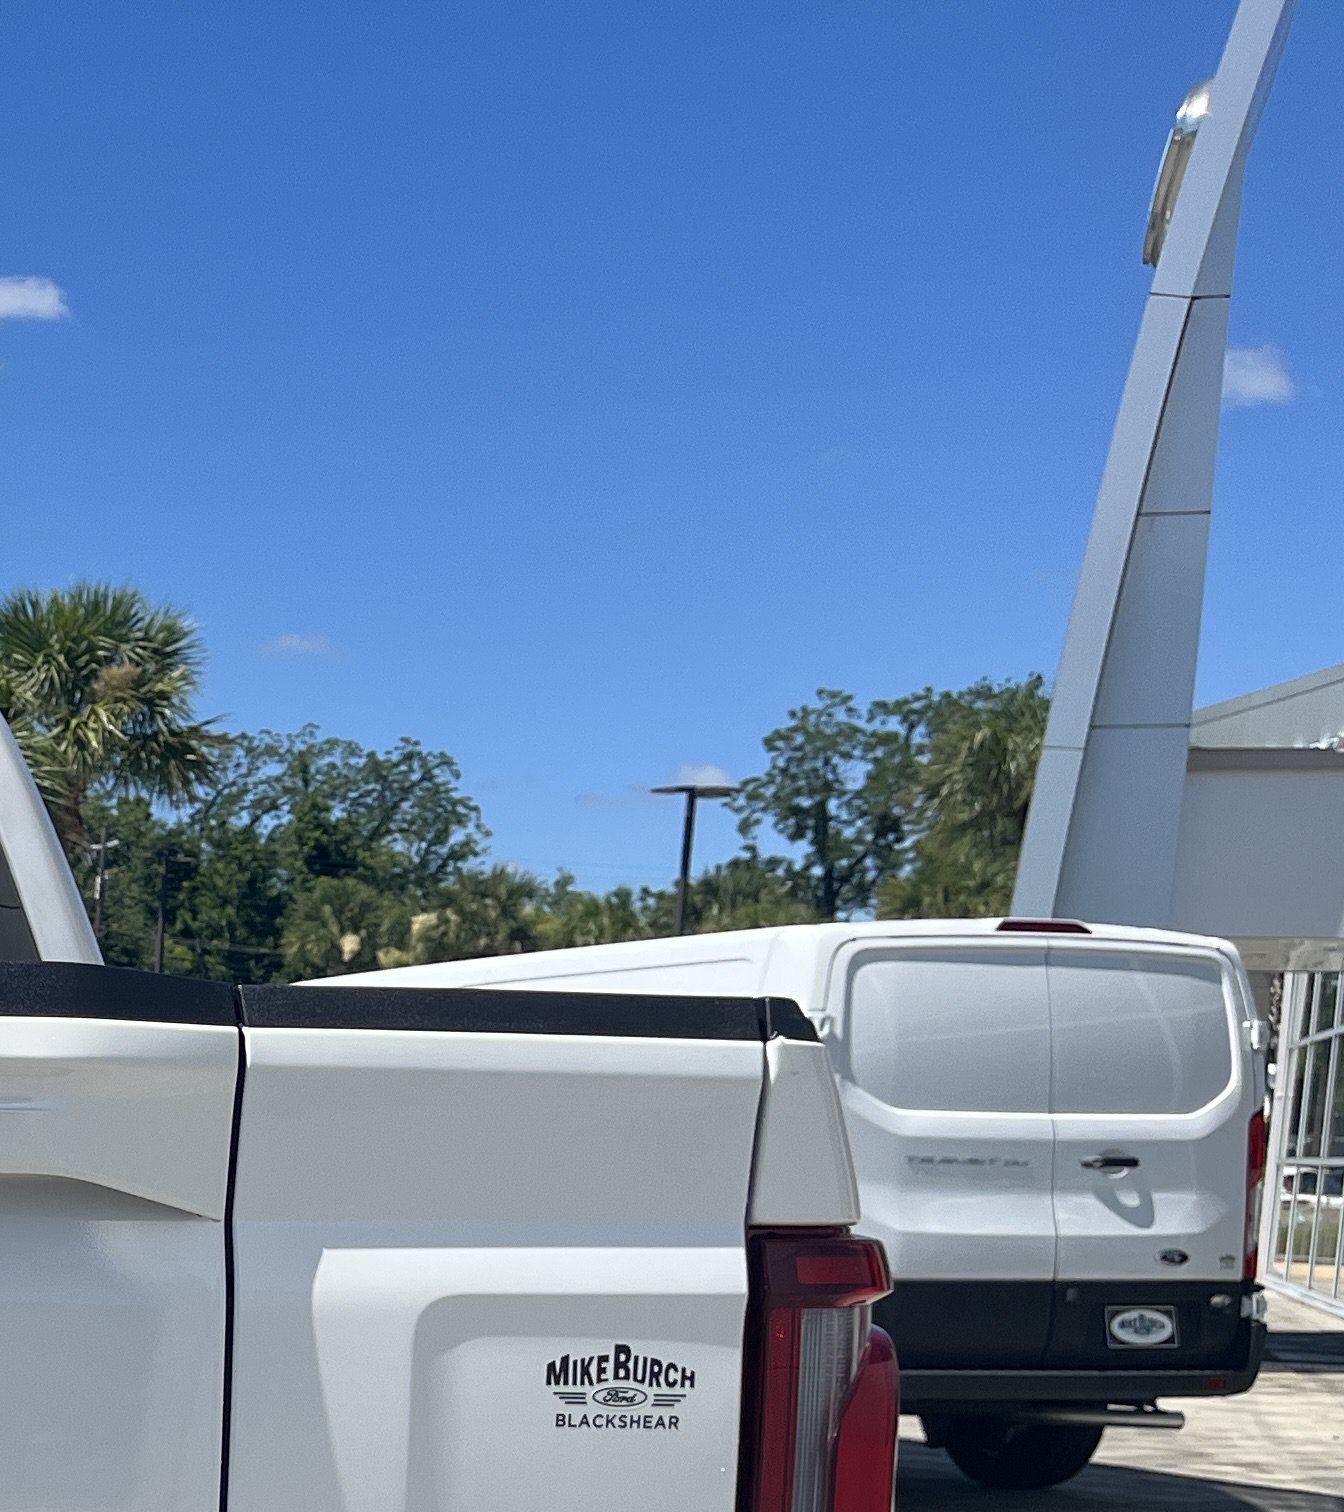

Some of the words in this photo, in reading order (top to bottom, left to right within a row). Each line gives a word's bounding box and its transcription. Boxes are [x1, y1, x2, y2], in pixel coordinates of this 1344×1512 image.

[545, 1353, 610, 1387] MIKE
[612, 1344, 696, 1389] BURCH
[603, 1389, 637, 1404] Ford
[555, 1413, 680, 1430] BLACKSHEAR
